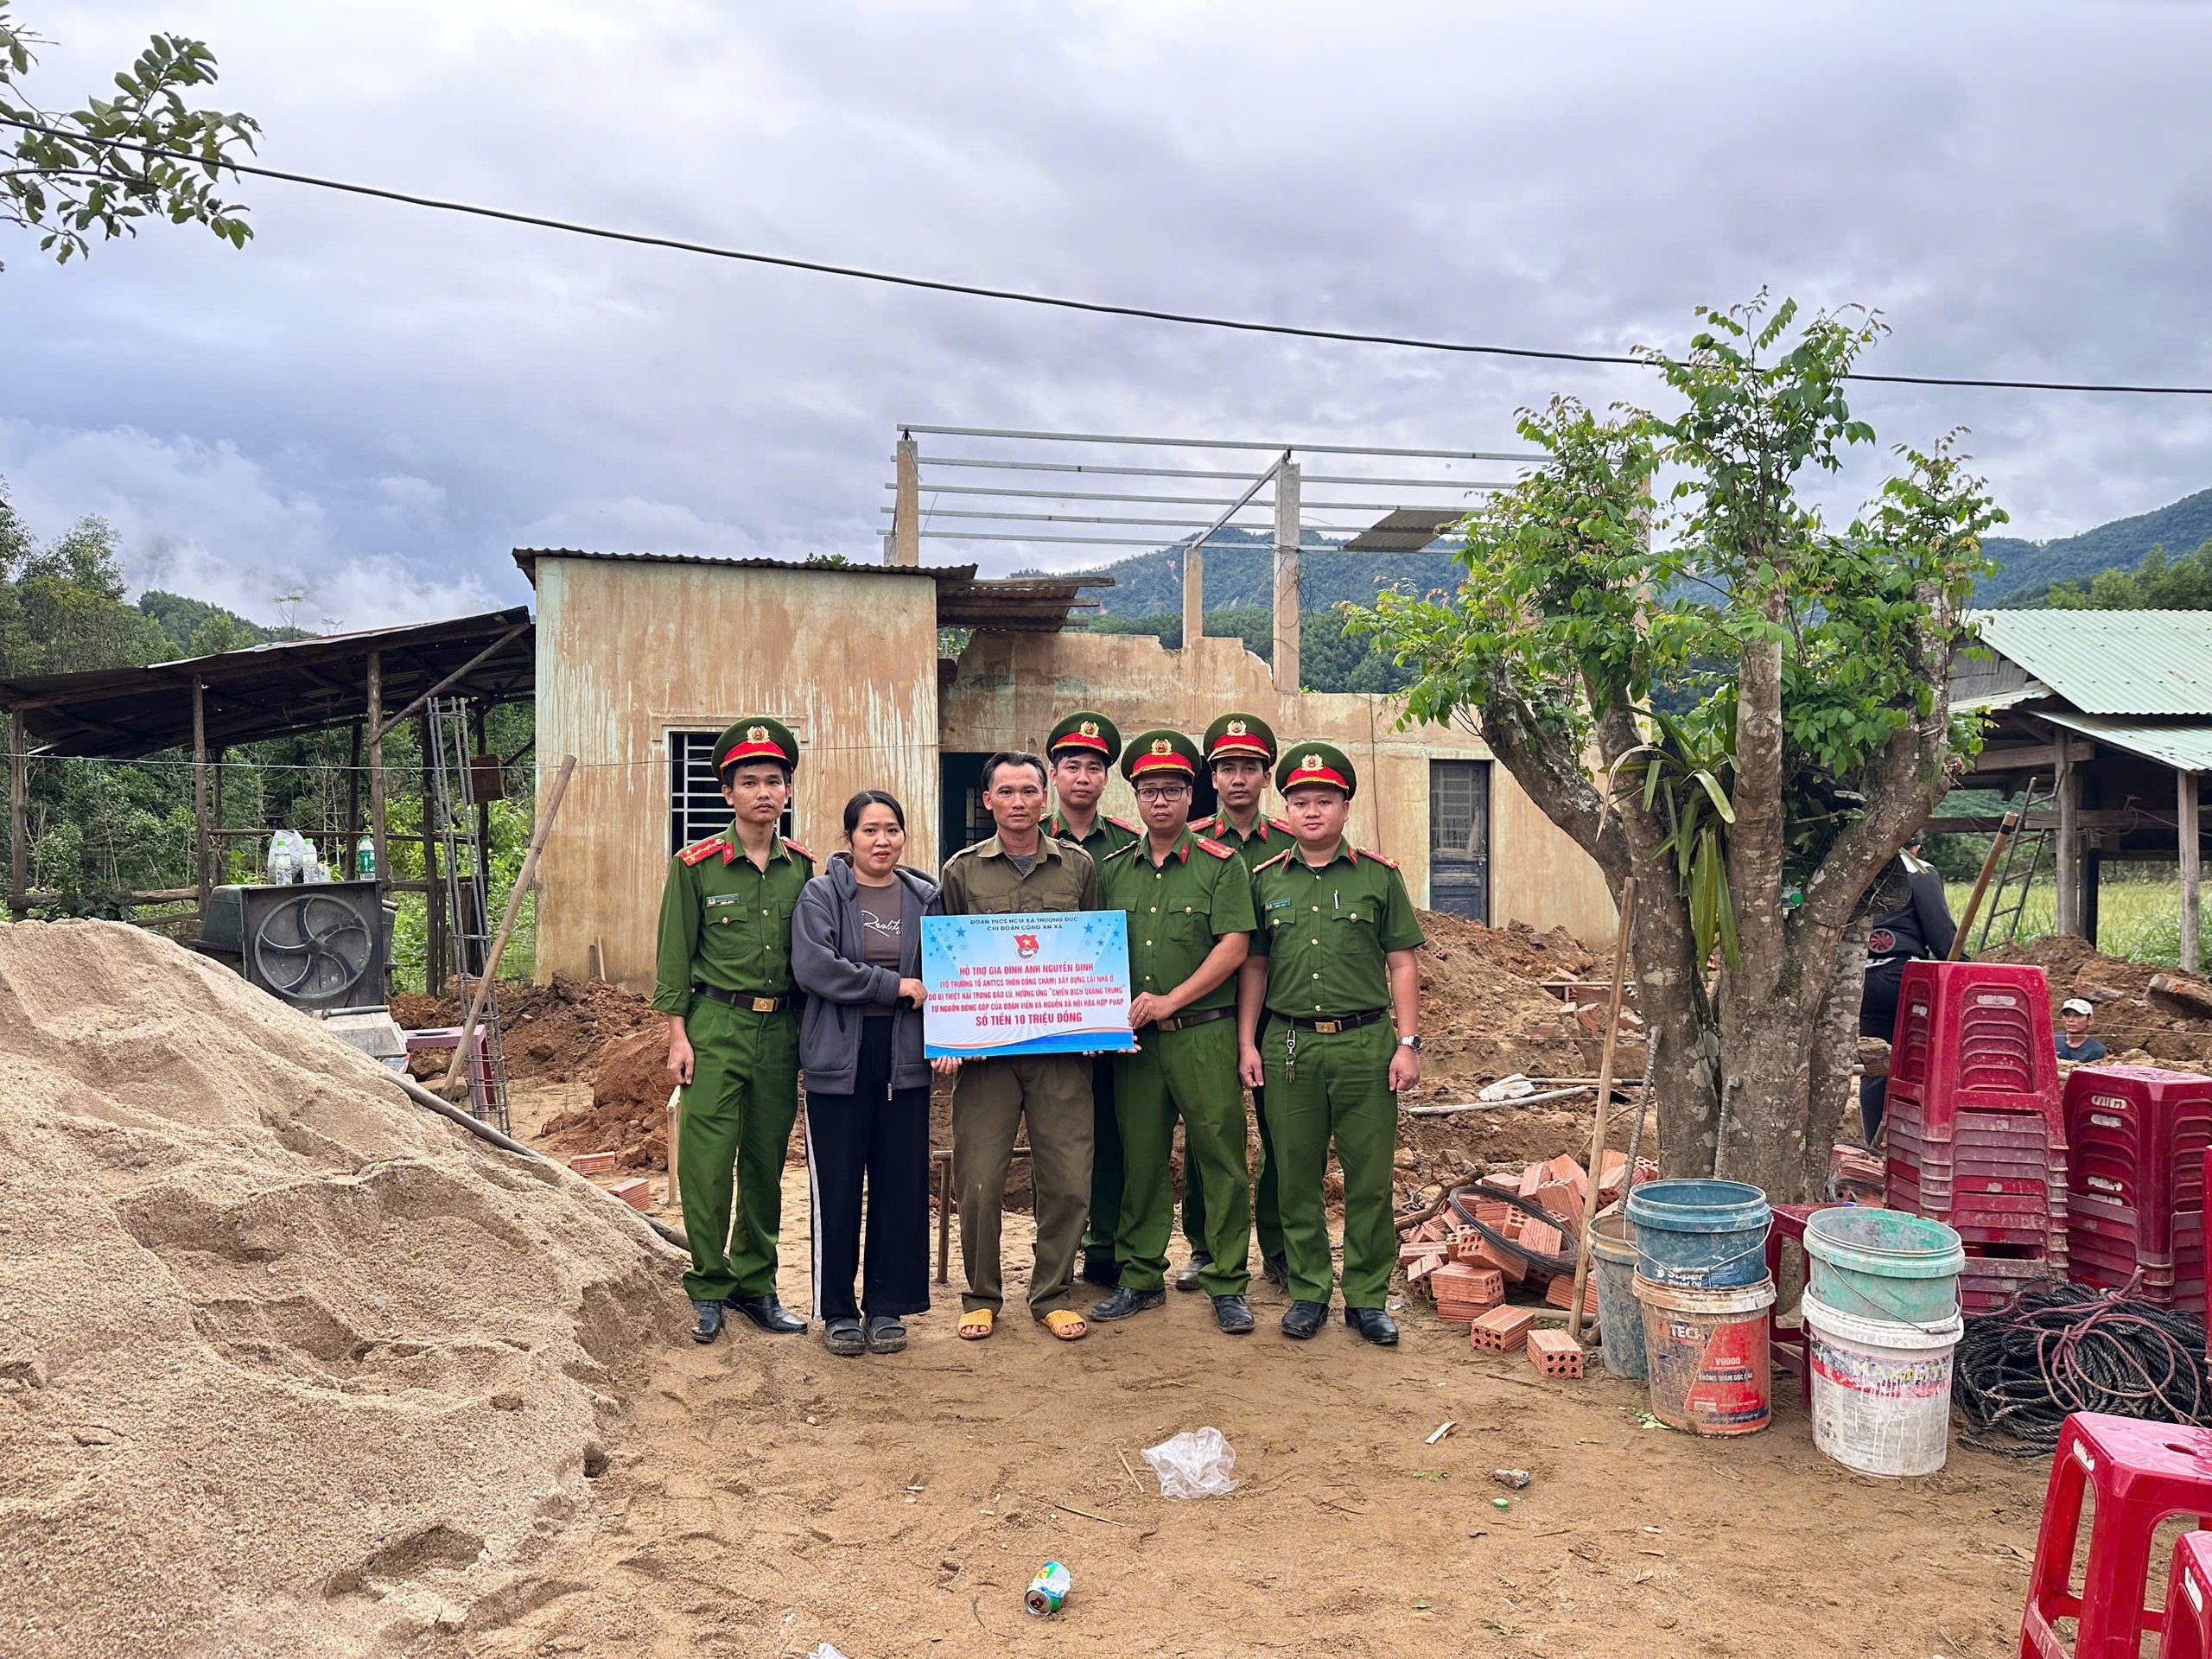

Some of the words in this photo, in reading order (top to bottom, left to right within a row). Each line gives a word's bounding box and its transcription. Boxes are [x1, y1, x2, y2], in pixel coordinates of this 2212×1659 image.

[972, 966, 987, 976] TRỢ
[989, 966, 1002, 975] GIA
[1004, 964, 1022, 975] ĐÌNH
[1025, 964, 1040, 974] ANH
[1058, 976, 1069, 984] XÂY
[1071, 976, 1086, 986] DỰNG
[1097, 974, 1109, 983] NHÀ
[1070, 988, 1084, 997] DỊCH
[1084, 987, 1103, 995] QUANG
[990, 1001, 1002, 1011] CỦA
[1109, 997, 1124, 1006] PHÁP
[976, 1012, 988, 1027] SỐ
[990, 1011, 1012, 1026] TIỀN
[1014, 1014, 1026, 1025] 10
[1028, 1011, 1054, 1027] TRIỆU
[1057, 1009, 1082, 1023] ĐỒNG
[1715, 1357, 1741, 1366] V9000
